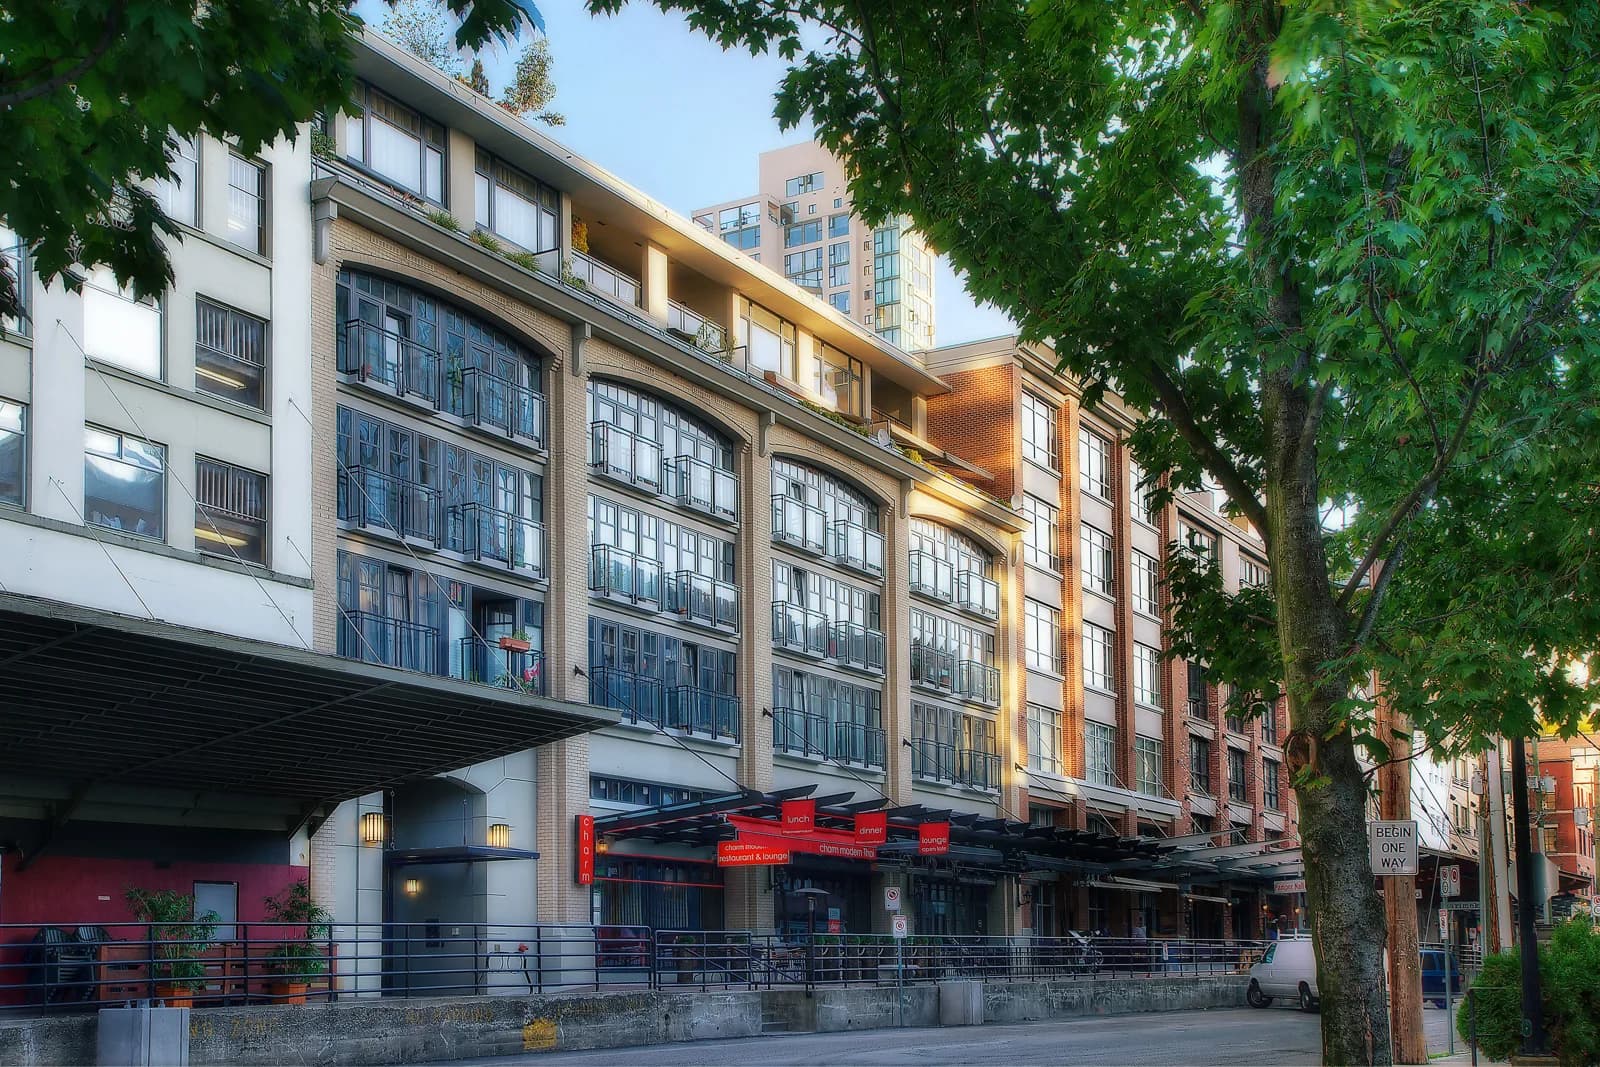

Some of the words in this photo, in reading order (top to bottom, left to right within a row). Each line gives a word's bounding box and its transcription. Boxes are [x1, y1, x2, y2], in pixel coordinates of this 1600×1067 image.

[787, 815, 810, 824] lunch
[859, 826, 883, 835] dinner
[1376, 827, 1411, 838] BEGIN
[921, 837, 947, 845] lounge
[582, 817, 590, 882] charm
[1381, 842, 1406, 853] ONE
[719, 853, 754, 863] restaurant
[755, 853, 762, 861] &
[762, 852, 788, 861] lounge
[1381, 857, 1406, 868] WAY
